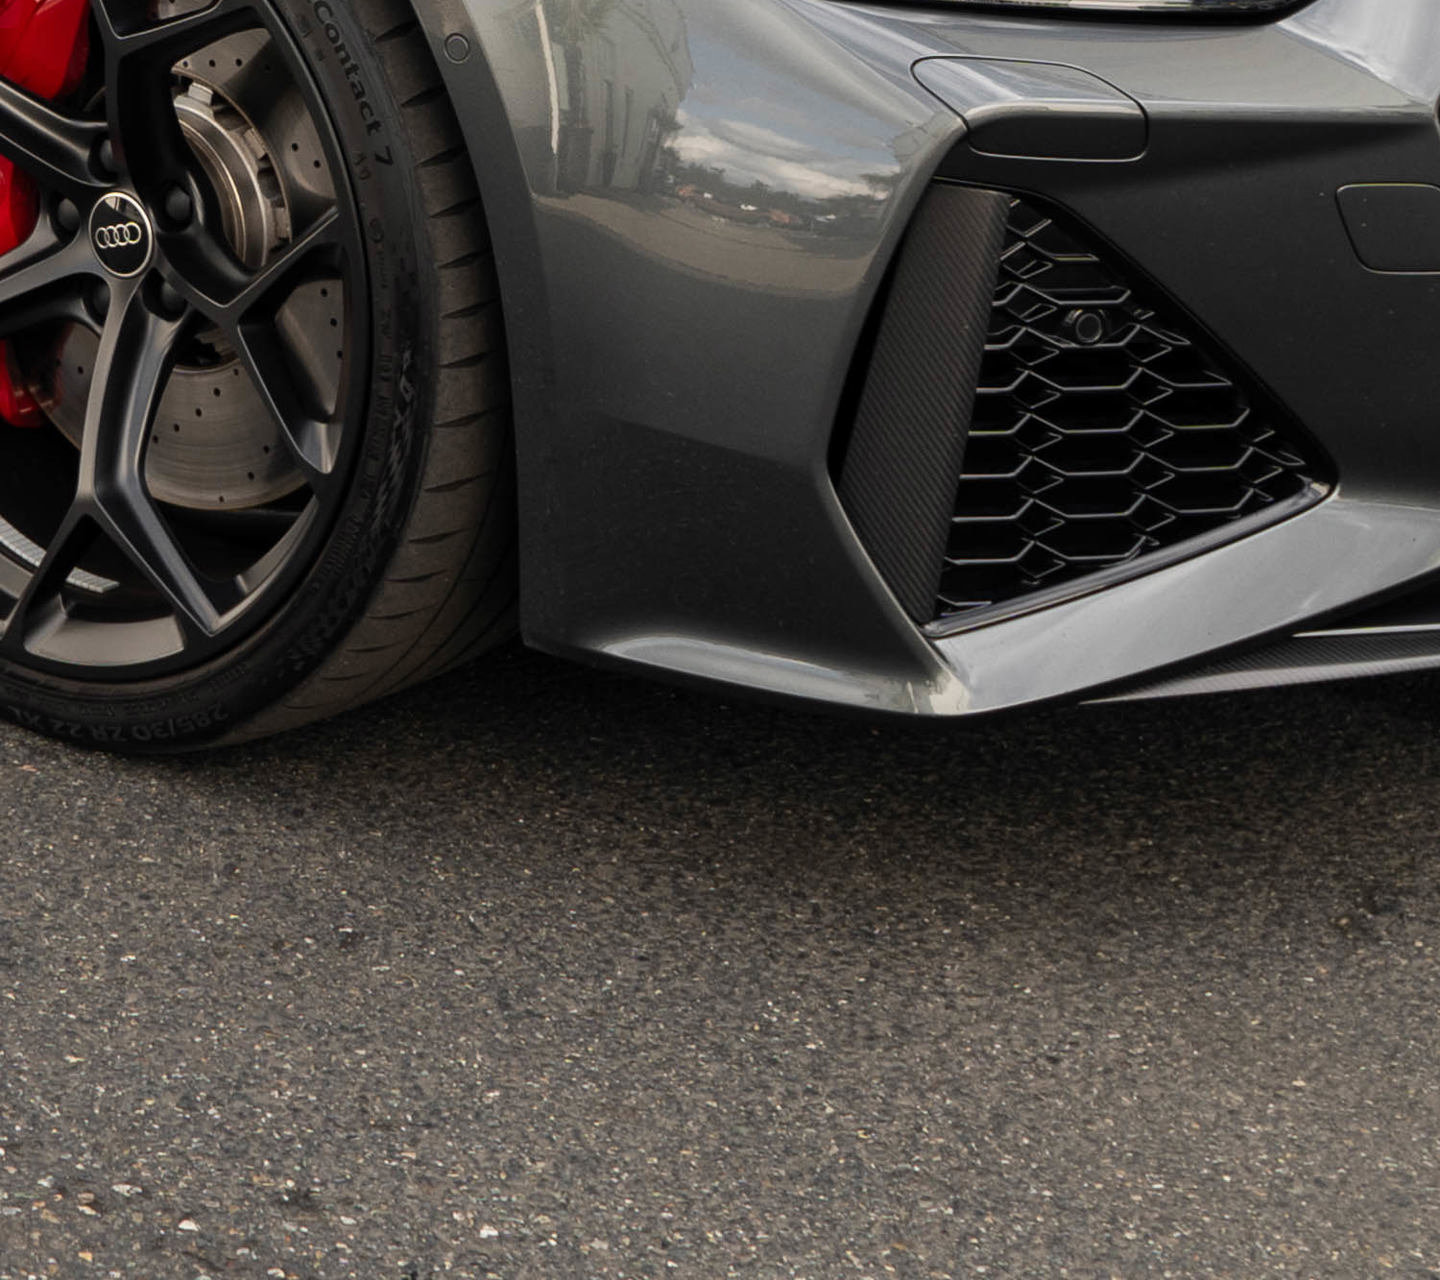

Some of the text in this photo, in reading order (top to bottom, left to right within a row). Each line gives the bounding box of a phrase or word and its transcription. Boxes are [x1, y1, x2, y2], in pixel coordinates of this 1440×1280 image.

[374, 144, 395, 167] 7
[48, 718, 83, 738] 22
[91, 724, 128, 742] ZR
[132, 704, 230, 742] 285/30
